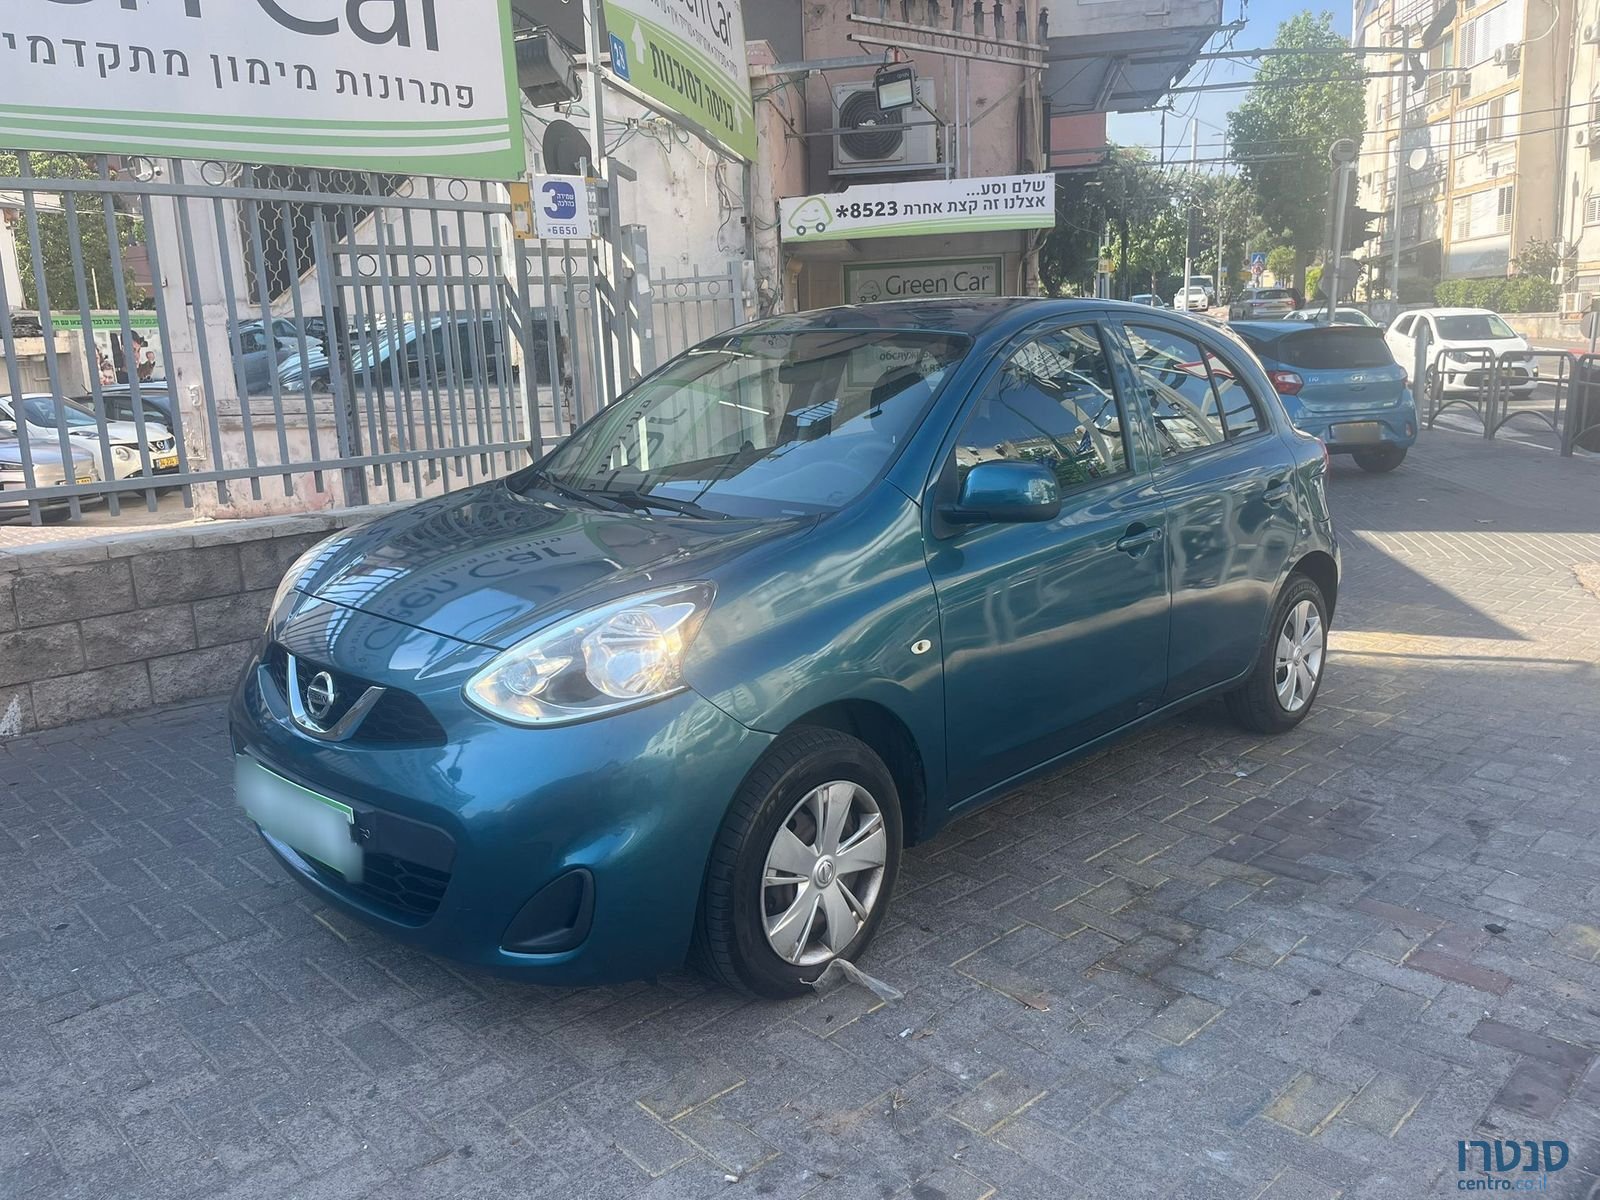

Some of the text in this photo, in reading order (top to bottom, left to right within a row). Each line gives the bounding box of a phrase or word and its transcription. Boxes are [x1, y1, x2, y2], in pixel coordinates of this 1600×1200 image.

[613, 42, 626, 70] 28
[209, 54, 317, 90] מימון
[335, 69, 474, 109] פתרונות
[705, 83, 734, 131] כניסה
[1012, 179, 1045, 194] שלם
[903, 202, 943, 215] אחרת
[947, 199, 978, 214] קצת
[983, 198, 999, 210] זה
[1003, 195, 1046, 209] אצלנו
[885, 271, 990, 295] Green Car
